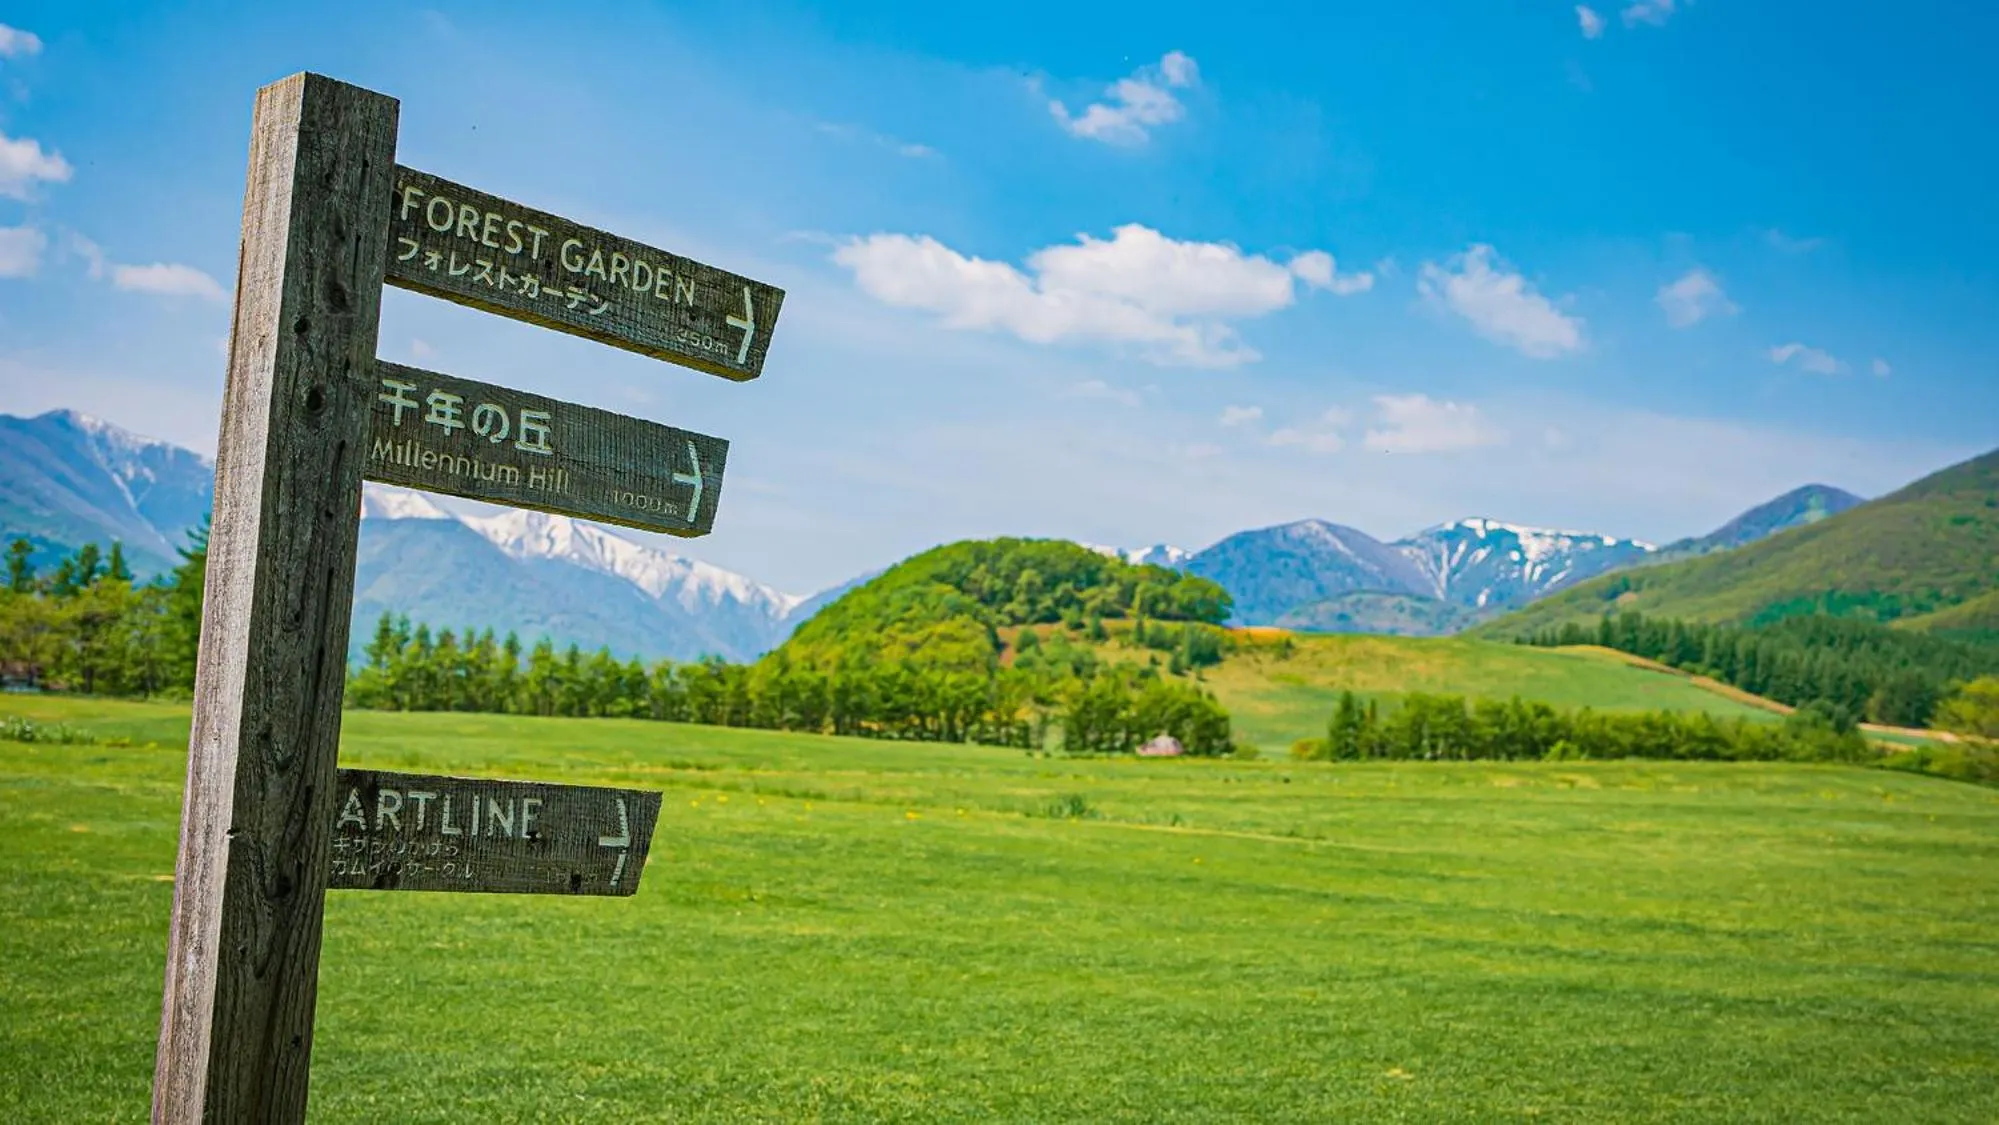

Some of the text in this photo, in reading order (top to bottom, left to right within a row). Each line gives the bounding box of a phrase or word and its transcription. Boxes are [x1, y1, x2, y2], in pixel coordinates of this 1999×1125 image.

[400, 186, 695, 307] FOREST GARDEN
[378, 378, 554, 454] 千年の丘
[370, 436, 570, 494] Millennium Hill
[336, 787, 543, 840] ARTLINE
